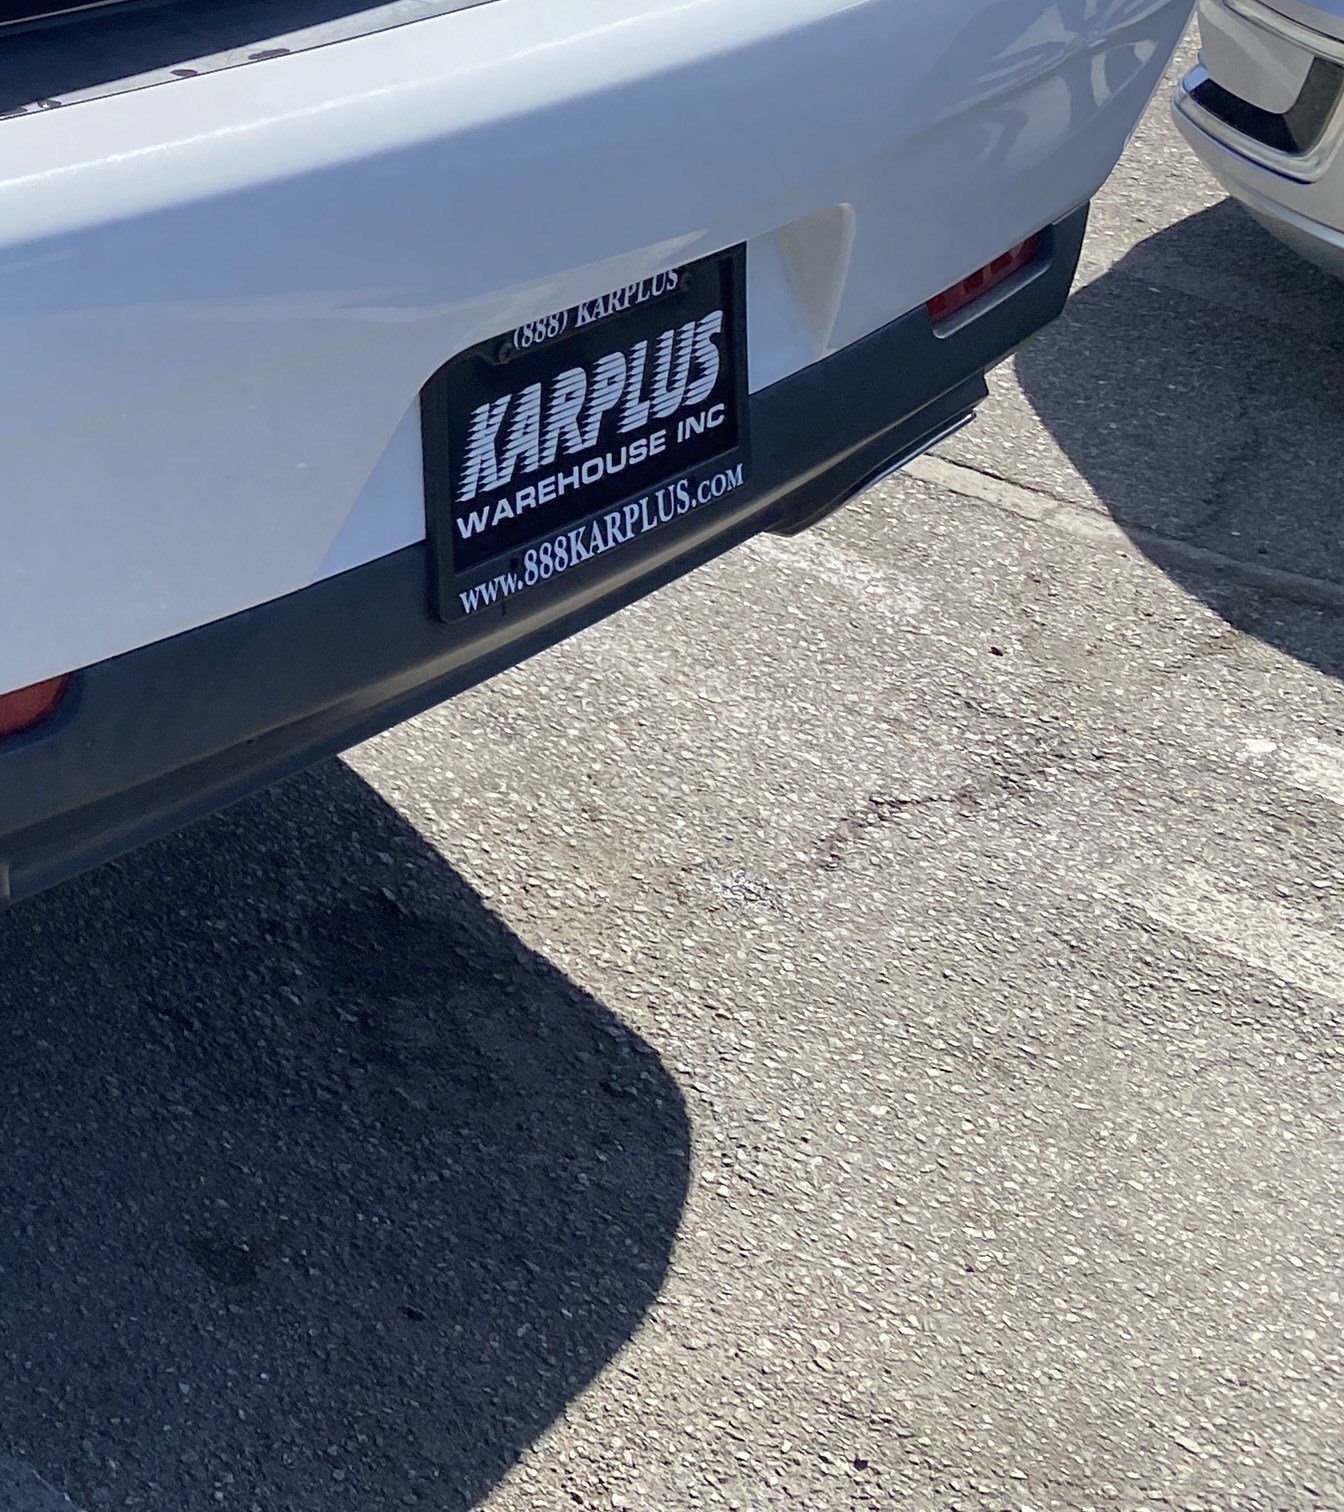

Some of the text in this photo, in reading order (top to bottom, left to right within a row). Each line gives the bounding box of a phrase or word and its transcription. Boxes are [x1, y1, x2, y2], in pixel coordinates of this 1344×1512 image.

[575, 267, 679, 328] KARPLUS
[454, 309, 724, 503] KARPLUS
[455, 402, 727, 540] WAREHOUSE INC
